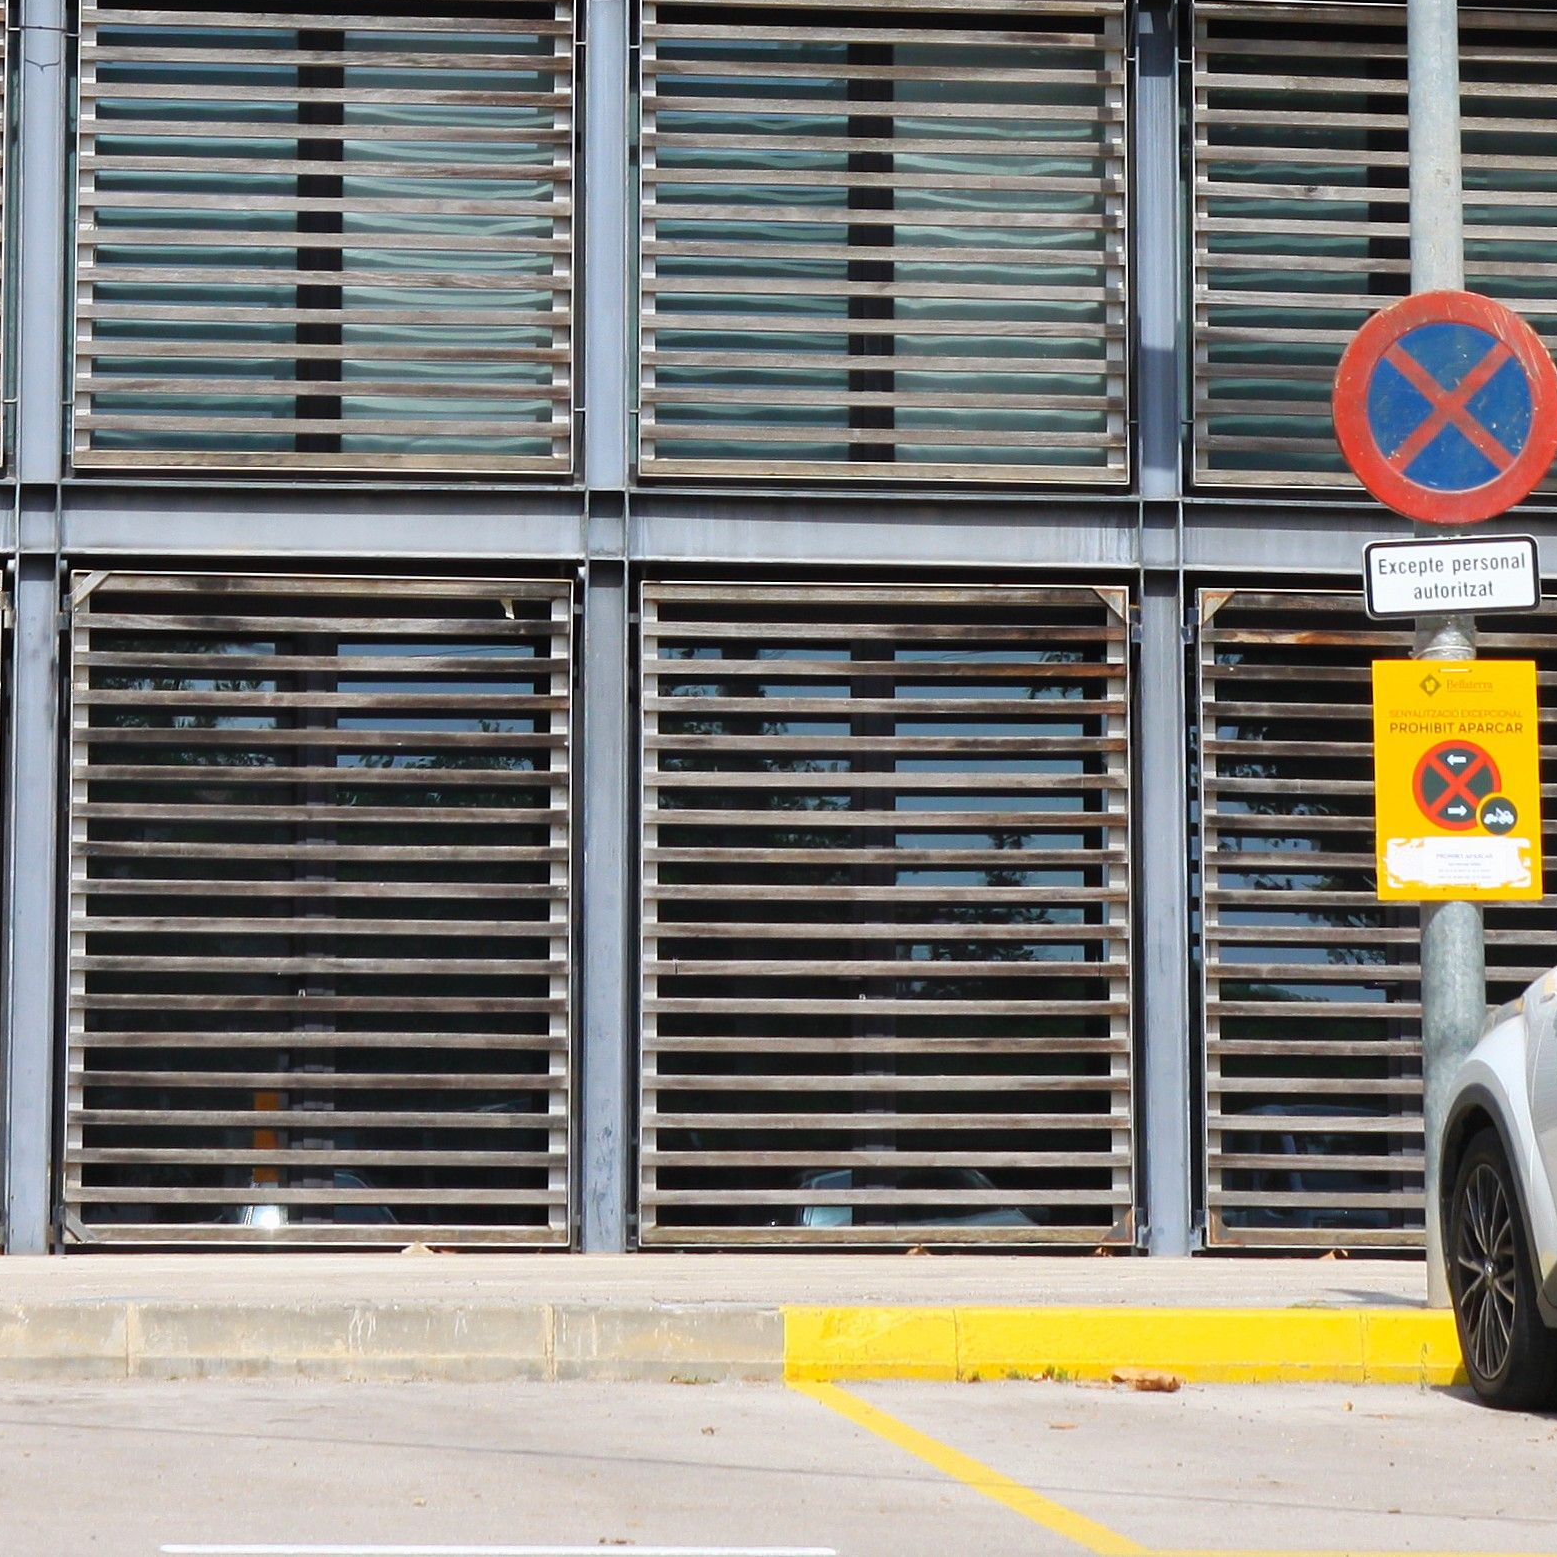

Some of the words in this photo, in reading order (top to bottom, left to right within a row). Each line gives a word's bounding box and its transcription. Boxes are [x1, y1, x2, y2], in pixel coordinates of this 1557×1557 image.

[1378, 557, 1444, 576] Excepte
[1452, 552, 1526, 575] personal
[1414, 580, 1494, 599] autoritzat
[1446, 679, 1494, 690] Bellaterra
[1389, 722, 1454, 734] PROHIBIT
[1458, 722, 1523, 734] APARCAR
